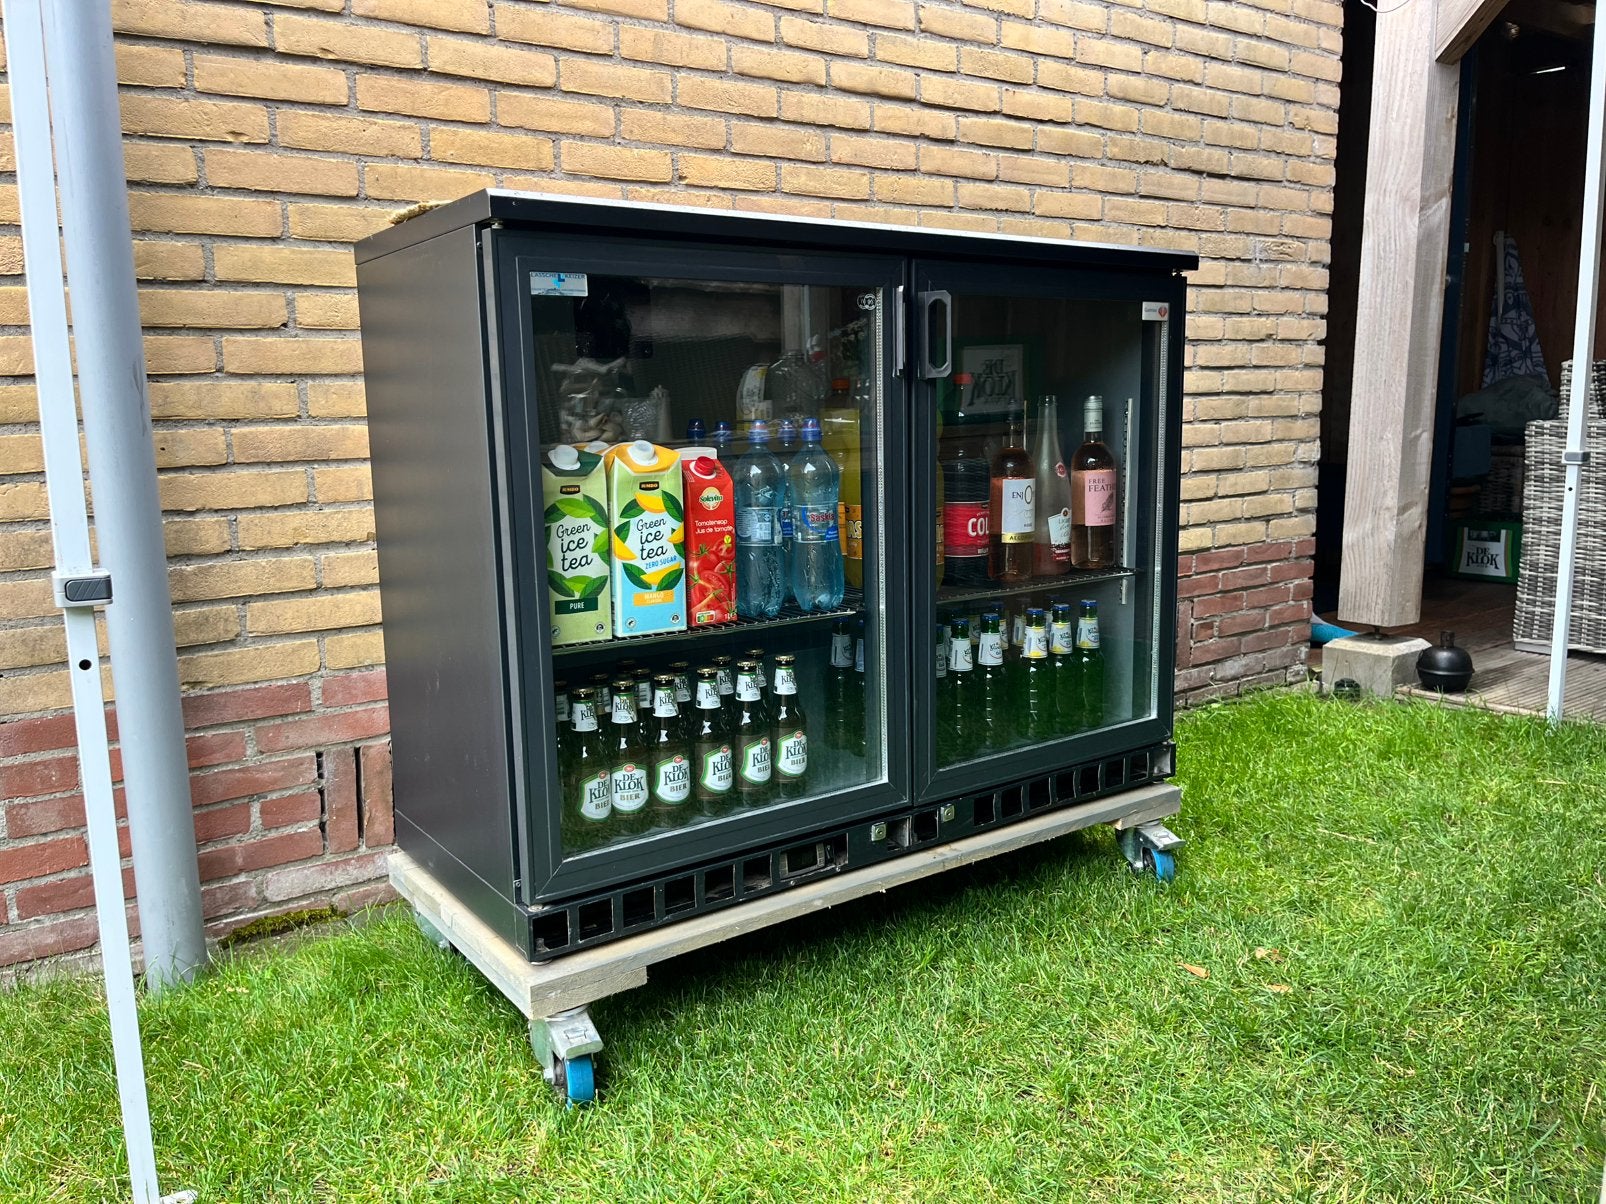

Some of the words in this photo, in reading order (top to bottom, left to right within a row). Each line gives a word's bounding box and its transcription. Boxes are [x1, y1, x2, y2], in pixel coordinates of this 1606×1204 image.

[556, 524, 591, 539] Green
[637, 518, 666, 531] Green
[640, 530, 664, 545] ice
[561, 537, 588, 553] ice
[640, 545, 668, 561] tea
[561, 554, 593, 572] tea
[645, 560, 659, 569] ZERO
[660, 555, 677, 566] SUGAR
[1466, 551, 1500, 570] KLOK
[569, 602, 585, 610] PURE
[664, 766, 689, 785] KLOK
[673, 764, 684, 773] DE
[597, 779, 608, 789] DE
[622, 773, 636, 781] DE
[614, 777, 644, 794] KLOK
[670, 783, 688, 792] BIER
[620, 793, 641, 801] BIER
